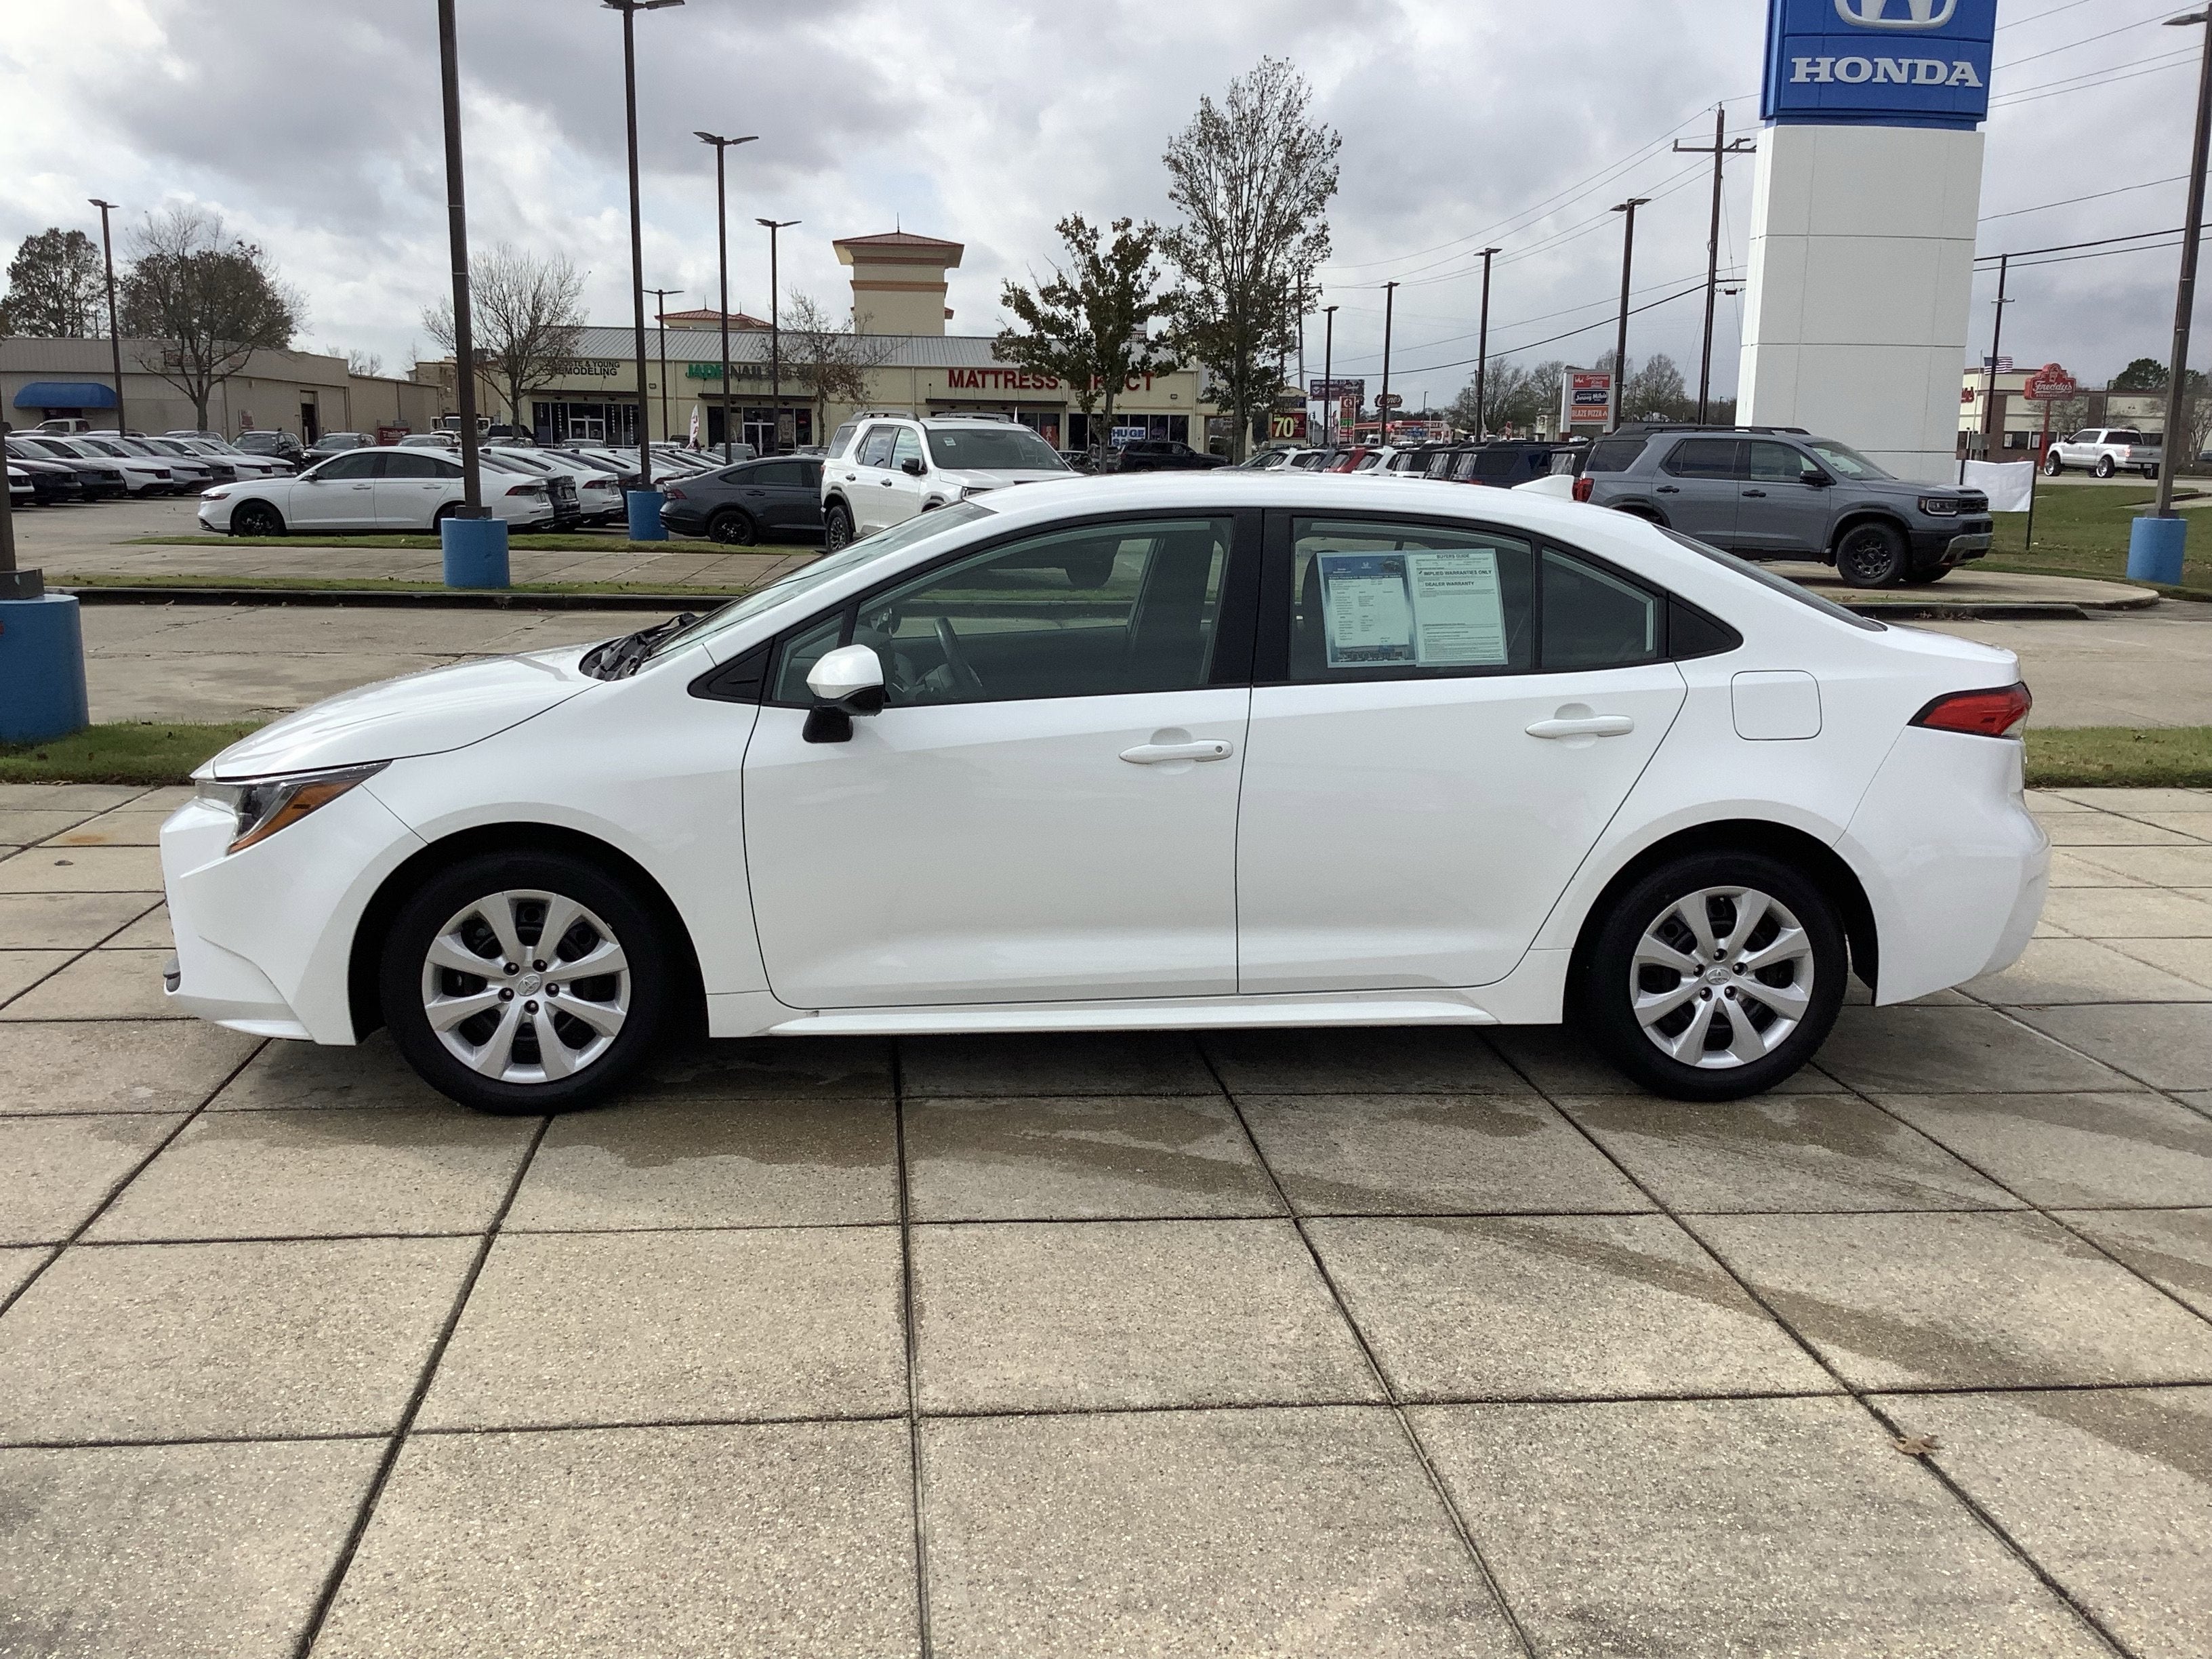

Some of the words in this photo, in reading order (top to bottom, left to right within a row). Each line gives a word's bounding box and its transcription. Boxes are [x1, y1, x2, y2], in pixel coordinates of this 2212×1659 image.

[1789, 56, 1983, 88] HONDA
[948, 369, 1059, 390] MATTRESS
[2032, 380, 2072, 393] Freddy's
[1376, 394, 1401, 407] Cne's
[1112, 429, 1145, 438] HUGE
